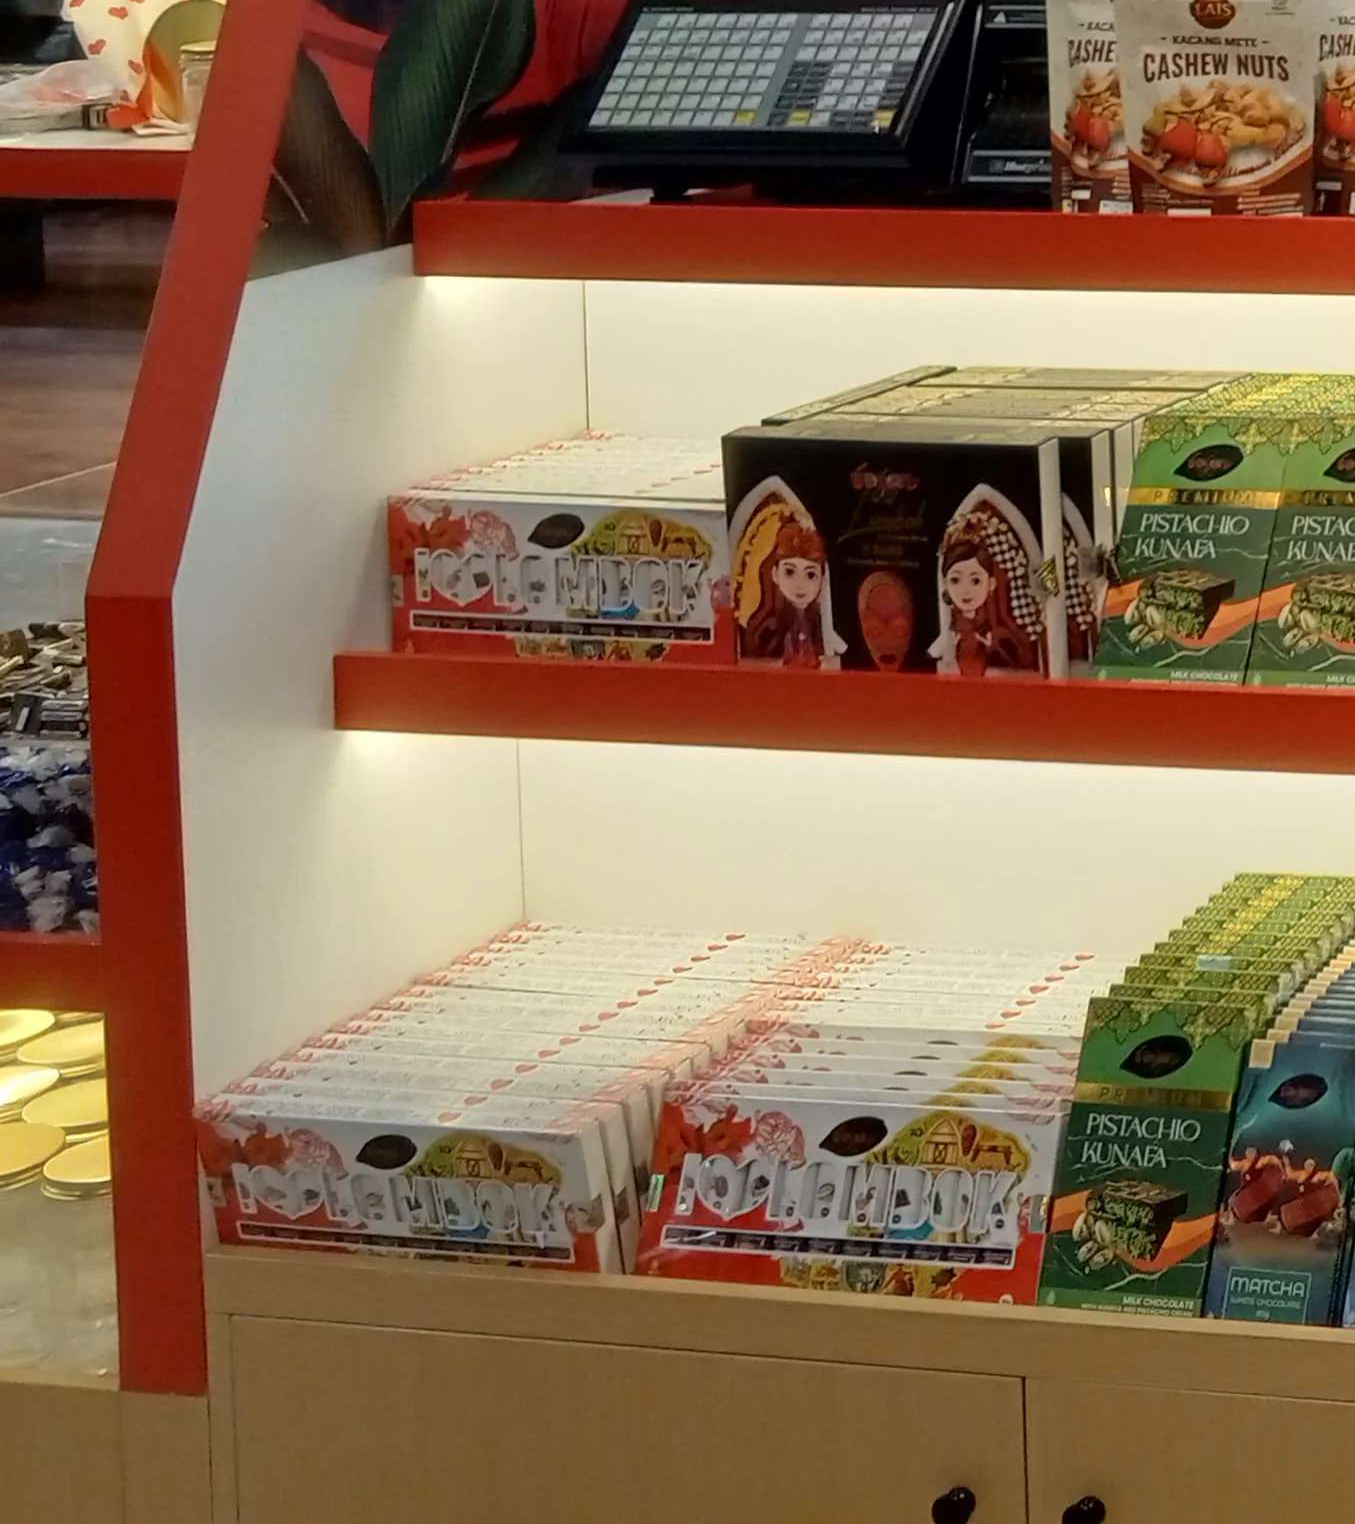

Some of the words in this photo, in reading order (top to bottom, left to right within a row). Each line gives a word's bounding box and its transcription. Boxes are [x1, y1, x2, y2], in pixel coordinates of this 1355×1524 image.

[1068, 39, 1118, 68] CASHE
[1143, 53, 1229, 83] CASHEW
[1237, 54, 1290, 82] NUTS
[1140, 512, 1251, 537] PISTACHIO
[1134, 537, 1218, 561] KUNAFA
[1086, 1113, 1201, 1142] PISTACHIO
[1081, 1141, 1168, 1168] KUNAFA
[1230, 1276, 1306, 1298] MATCHA
